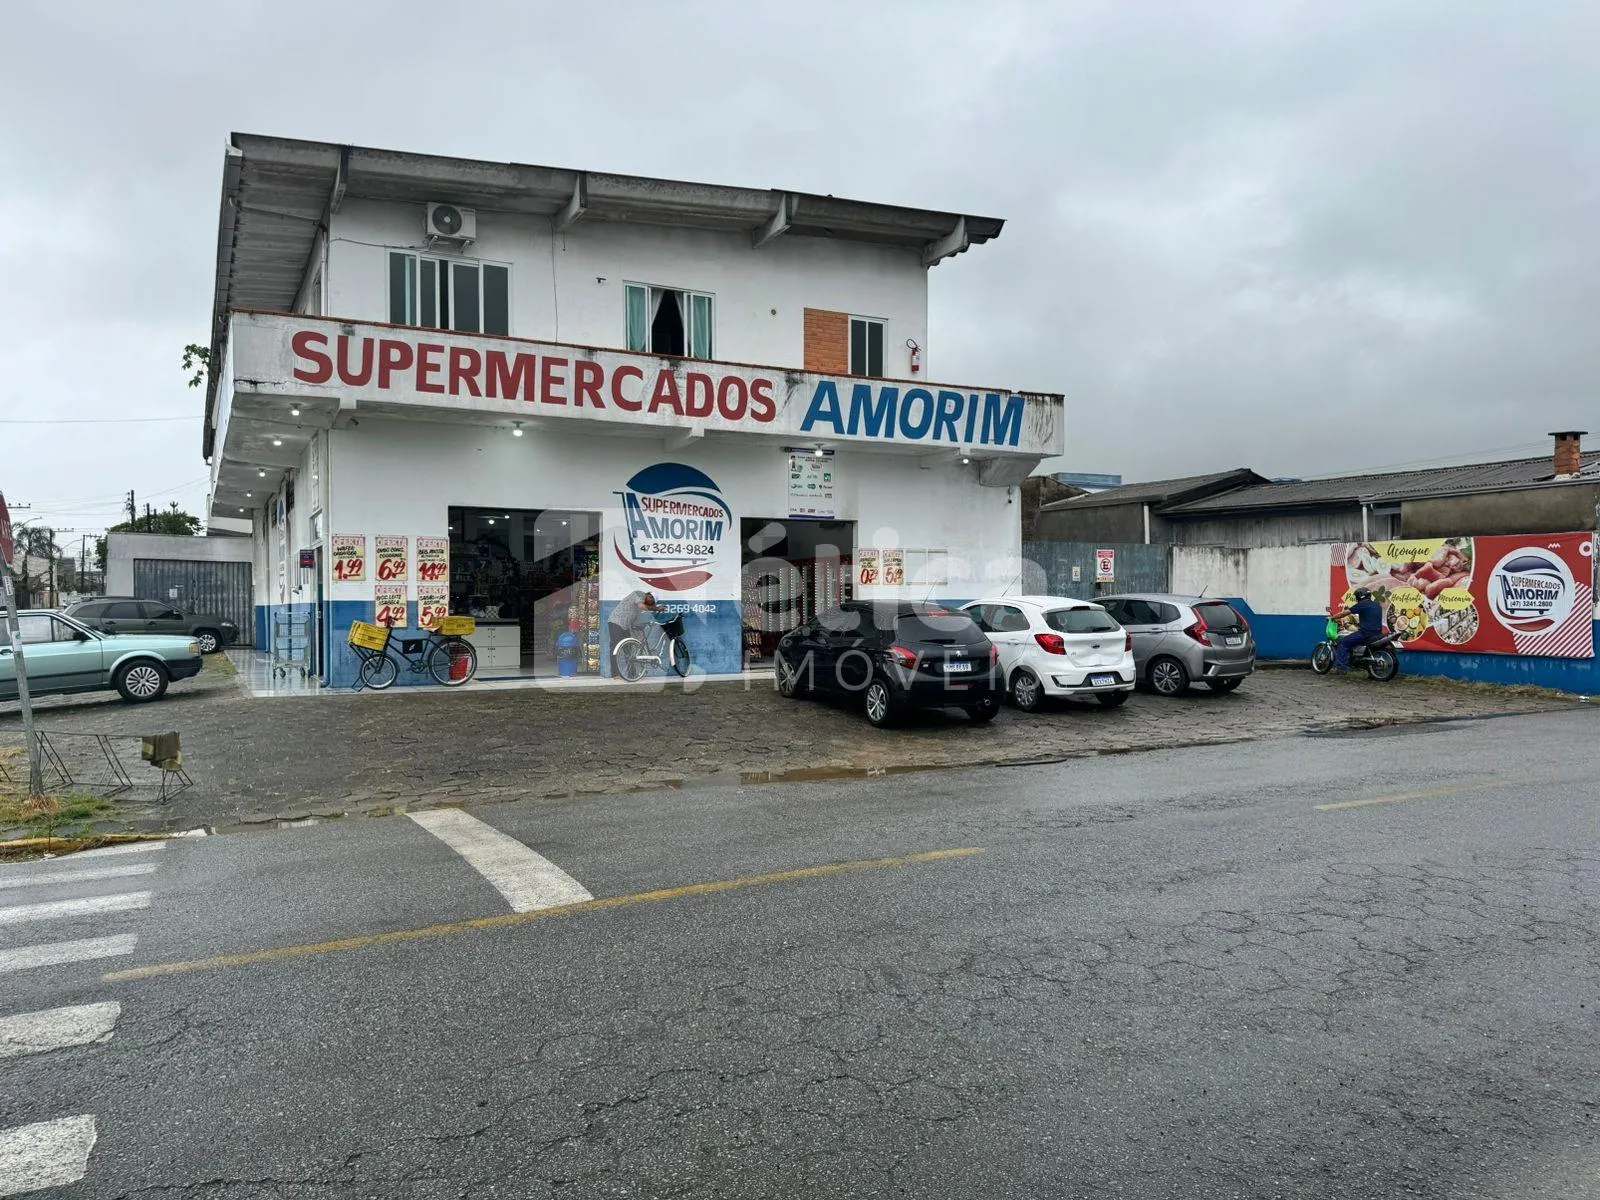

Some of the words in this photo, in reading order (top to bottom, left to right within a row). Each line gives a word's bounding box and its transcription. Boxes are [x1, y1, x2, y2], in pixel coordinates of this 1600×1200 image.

[291, 330, 777, 424] SUPERMERCADOS
[800, 380, 1025, 447] AMORIM
[626, 493, 724, 541] AMORIM
[641, 497, 724, 518] SUPERMERCADOS
[641, 544, 650, 552] 47
[652, 543, 715, 555] 3264-9824
[1387, 543, 1430, 560] Açougue
[1502, 575, 1559, 600] AMORIM
[1511, 576, 1561, 590] SUPERMERCADOS
